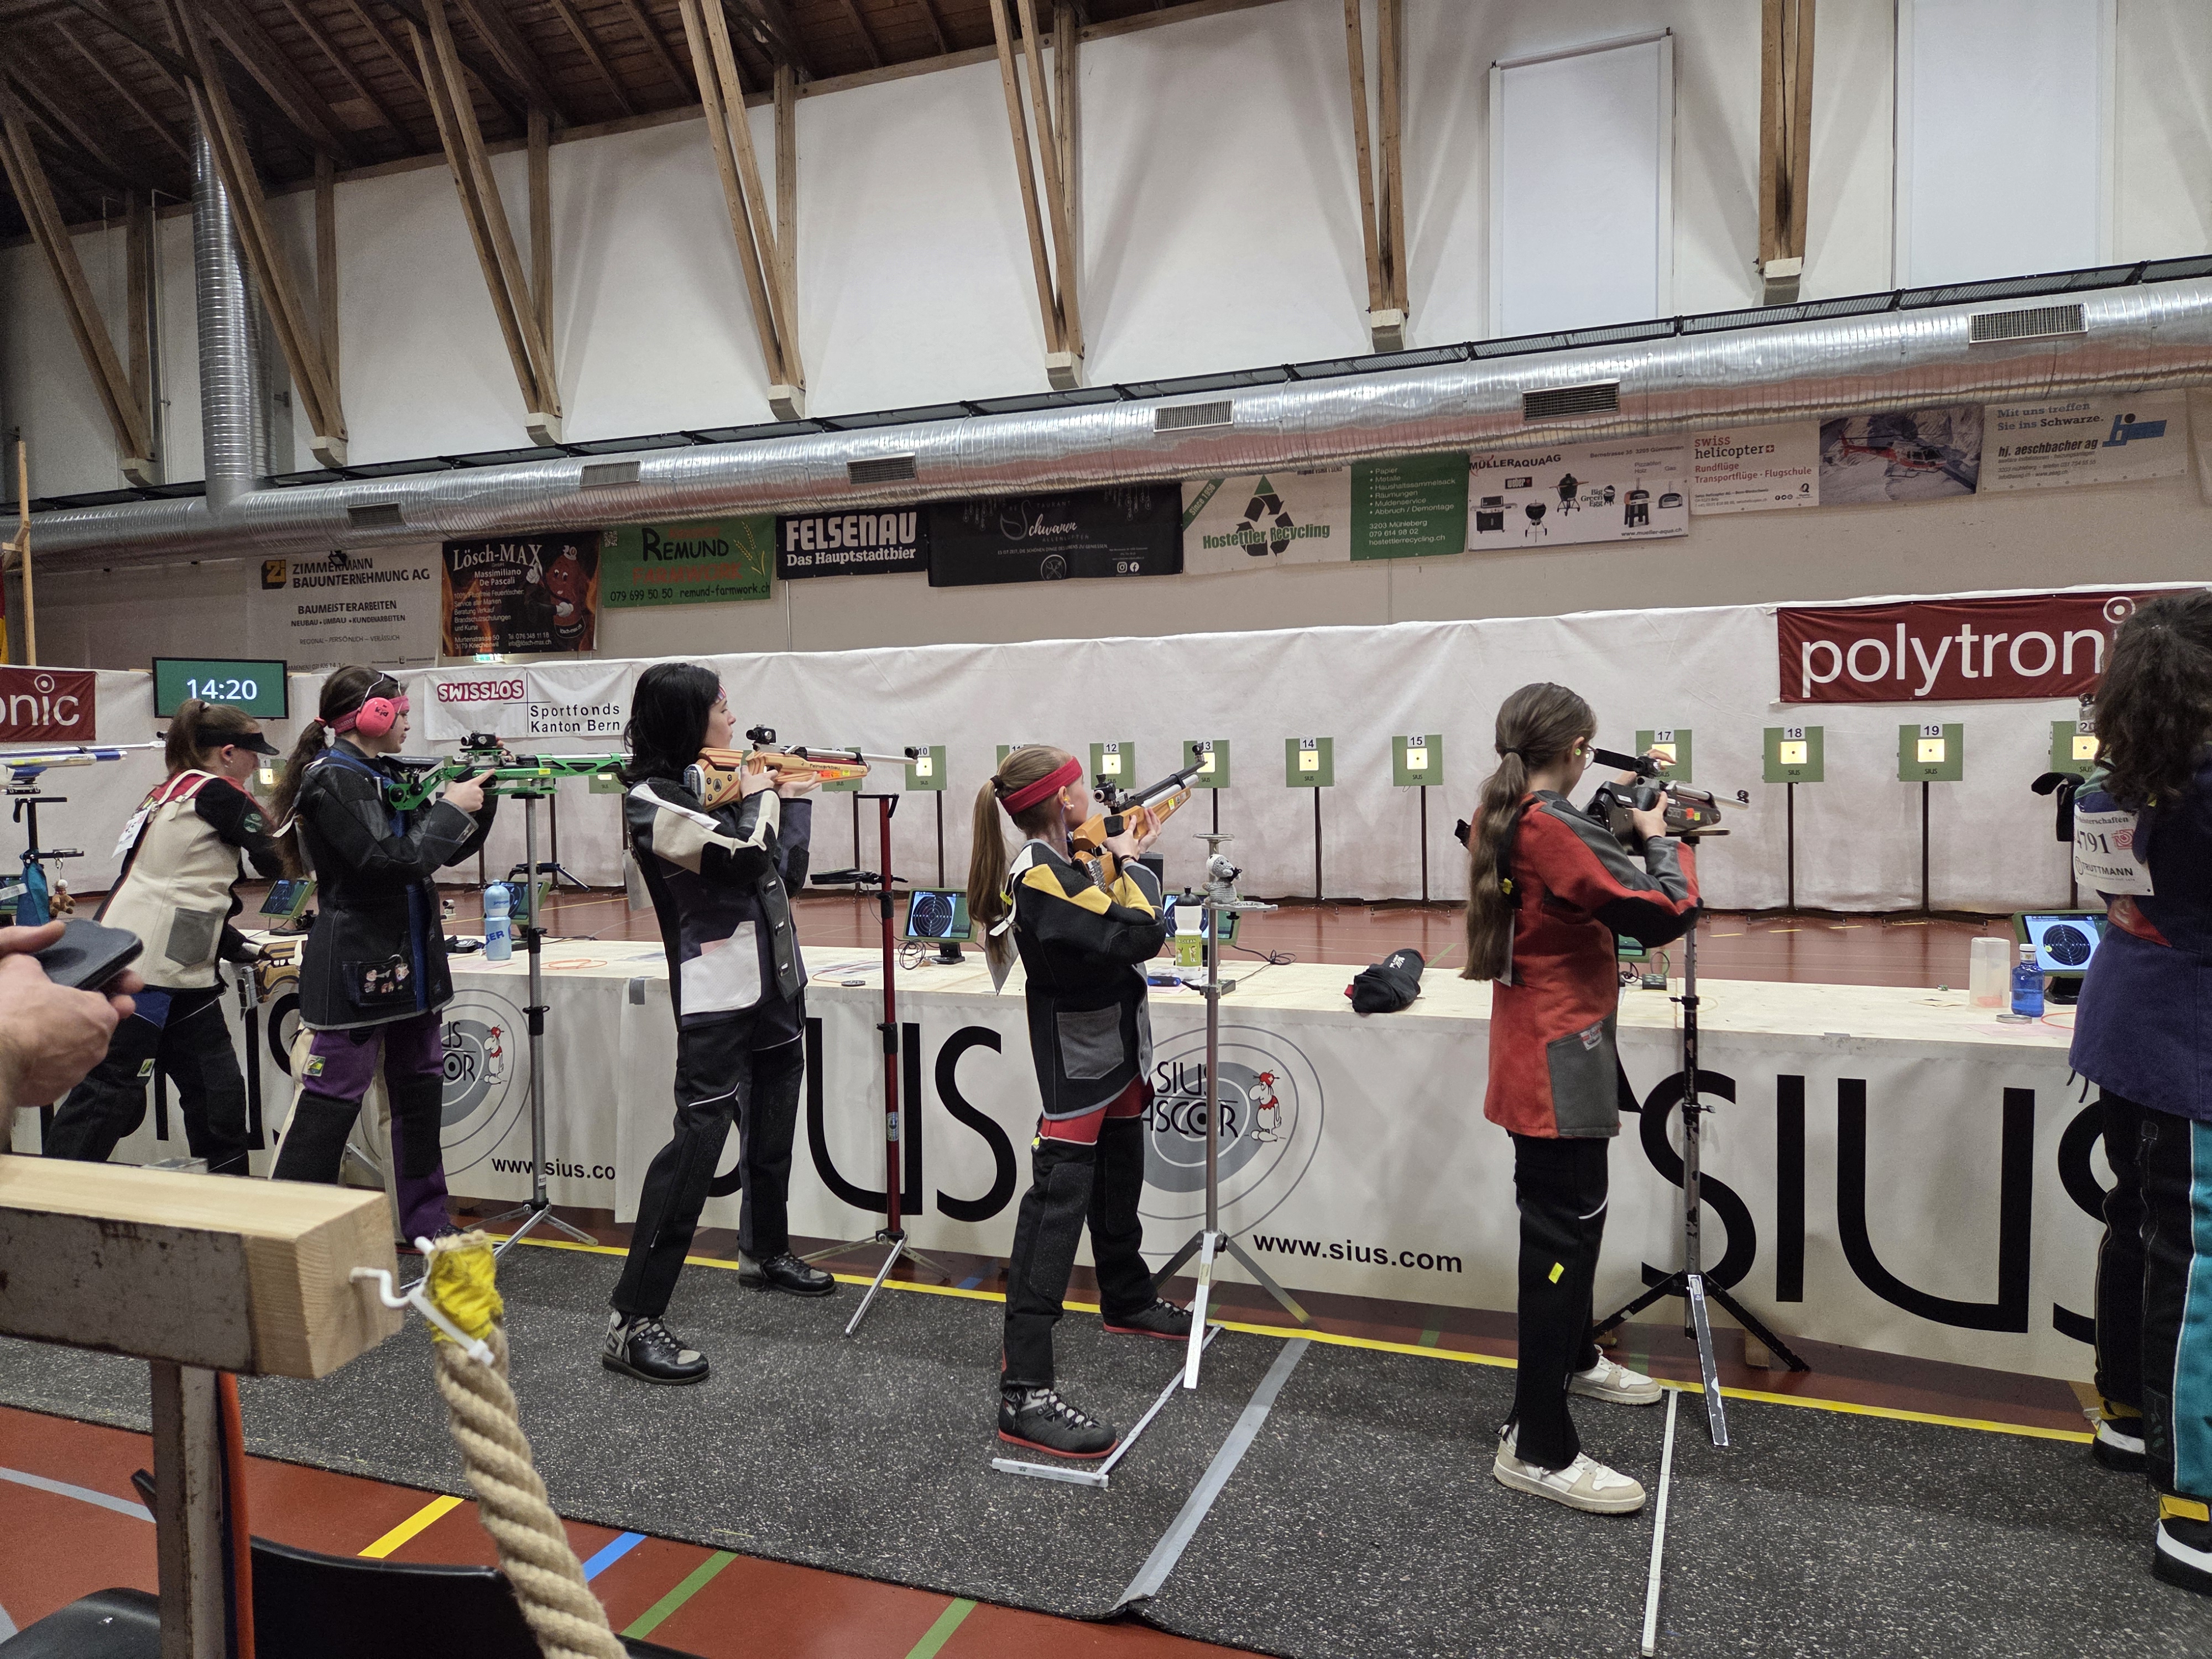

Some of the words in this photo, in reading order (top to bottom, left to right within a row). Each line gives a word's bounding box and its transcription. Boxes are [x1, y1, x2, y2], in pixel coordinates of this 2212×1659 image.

[1997, 409, 2019, 418] Mit
[2023, 408, 2044, 416] uns
[2048, 401, 2090, 414] treffen
[1998, 422, 2016, 431] Sie
[2019, 420, 2037, 429] ins
[2040, 415, 2104, 427] Schwarze.
[1694, 435, 1730, 447] swiss
[2015, 439, 2083, 456] aeschbacher
[2084, 439, 2098, 450] ag
[1694, 445, 1764, 460] helicopter
[1695, 462, 1739, 473] Rundflüge
[1695, 472, 1758, 483] Transportflüge
[1765, 467, 1812, 478] Flugschule
[1189, 496, 1204, 517] Since
[1201, 482, 1216, 499] 1956
[1375, 498, 1427, 507] Muldenservice
[1411, 504, 1454, 513] Demontage
[786, 512, 917, 551] FELSENAU
[1389, 520, 1428, 528] Mühleberg
[641, 528, 729, 561] REMUND
[1203, 530, 1266, 550] Hostettler
[1270, 524, 1331, 541] Recycling
[453, 544, 543, 576] Lösch-MAX
[787, 554, 812, 566] Das
[815, 546, 916, 565] Hauptstadtbier
[293, 569, 409, 588] BAUUNTERNEHMUNG
[413, 568, 430, 580] AG
[474, 568, 521, 578] Massimiliano
[632, 562, 743, 586] FARMWORK
[491, 577, 515, 586] Pascali
[610, 591, 627, 602] 079
[629, 589, 644, 601] 699
[648, 588, 658, 599] 50
[661, 587, 672, 598] 50
[680, 581, 770, 598] remund-farmwork.ch
[298, 601, 397, 614] BAUMEISTERARBEITEN
[352, 614, 405, 624] KUNDENARBEITEN
[1802, 597, 2135, 698] polytron
[187, 679, 257, 700] 14:20
[437, 680, 524, 701] SWISSLOS
[0, 674, 80, 726] nic
[530, 703, 620, 719] Sportfonds
[531, 721, 580, 733] Kanton
[587, 719, 620, 731] Bern
[1787, 728, 1802, 738] 18
[1924, 726, 1939, 735] 19
[1411, 737, 1422, 745] 15
[1658, 731, 1671, 740] 17
[918, 747, 927, 755] 10
[1106, 744, 1117, 752] 12
[1303, 739, 1314, 748] 14
[2081, 862, 2133, 877] TRUTTMANN
[1254, 1233, 1463, 1273] www.sius.com
